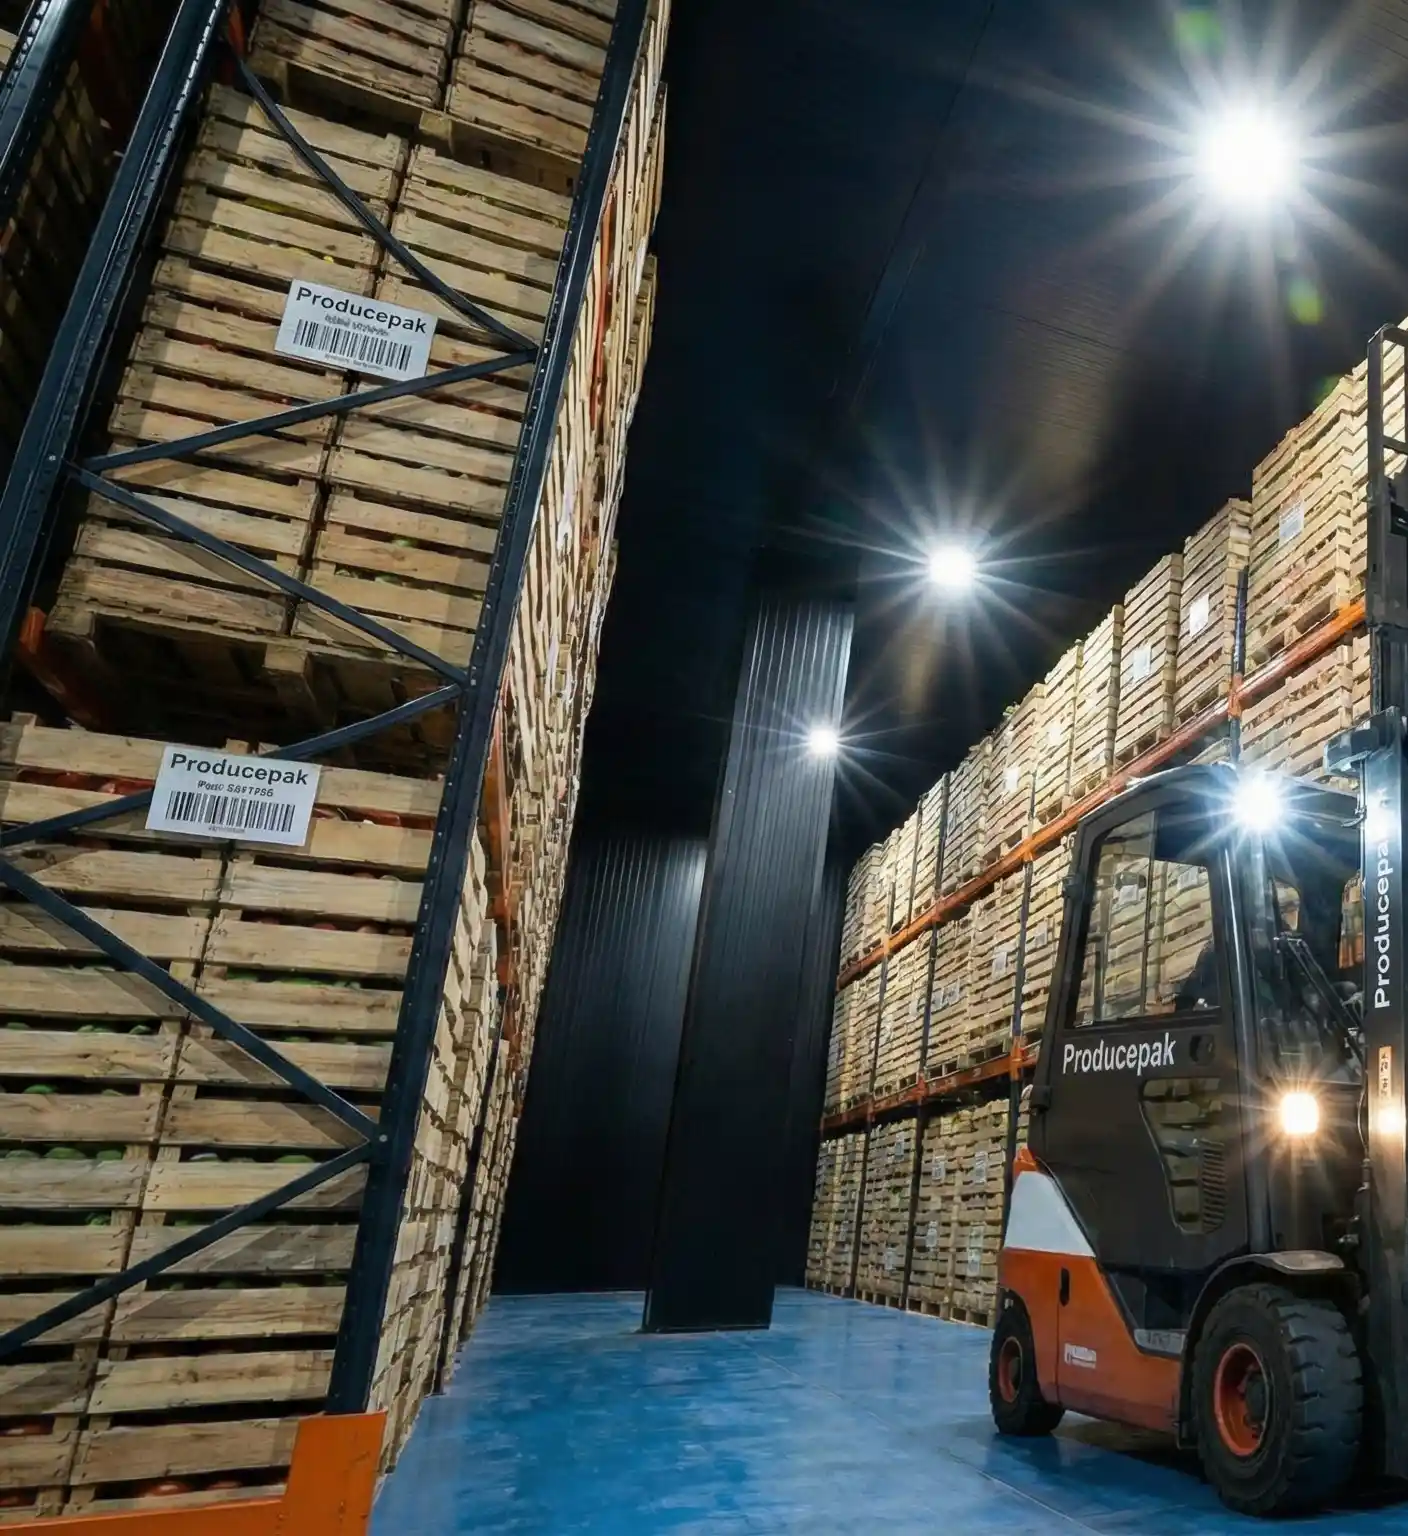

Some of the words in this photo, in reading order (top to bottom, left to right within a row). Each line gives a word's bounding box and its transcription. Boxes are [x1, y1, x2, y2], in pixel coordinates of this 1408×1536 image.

[296, 286, 427, 334] Producepak
[170, 753, 309, 786] Producepak
[1374, 822, 1393, 1009] Producepa
[1062, 1032, 1177, 1076] Producepak
